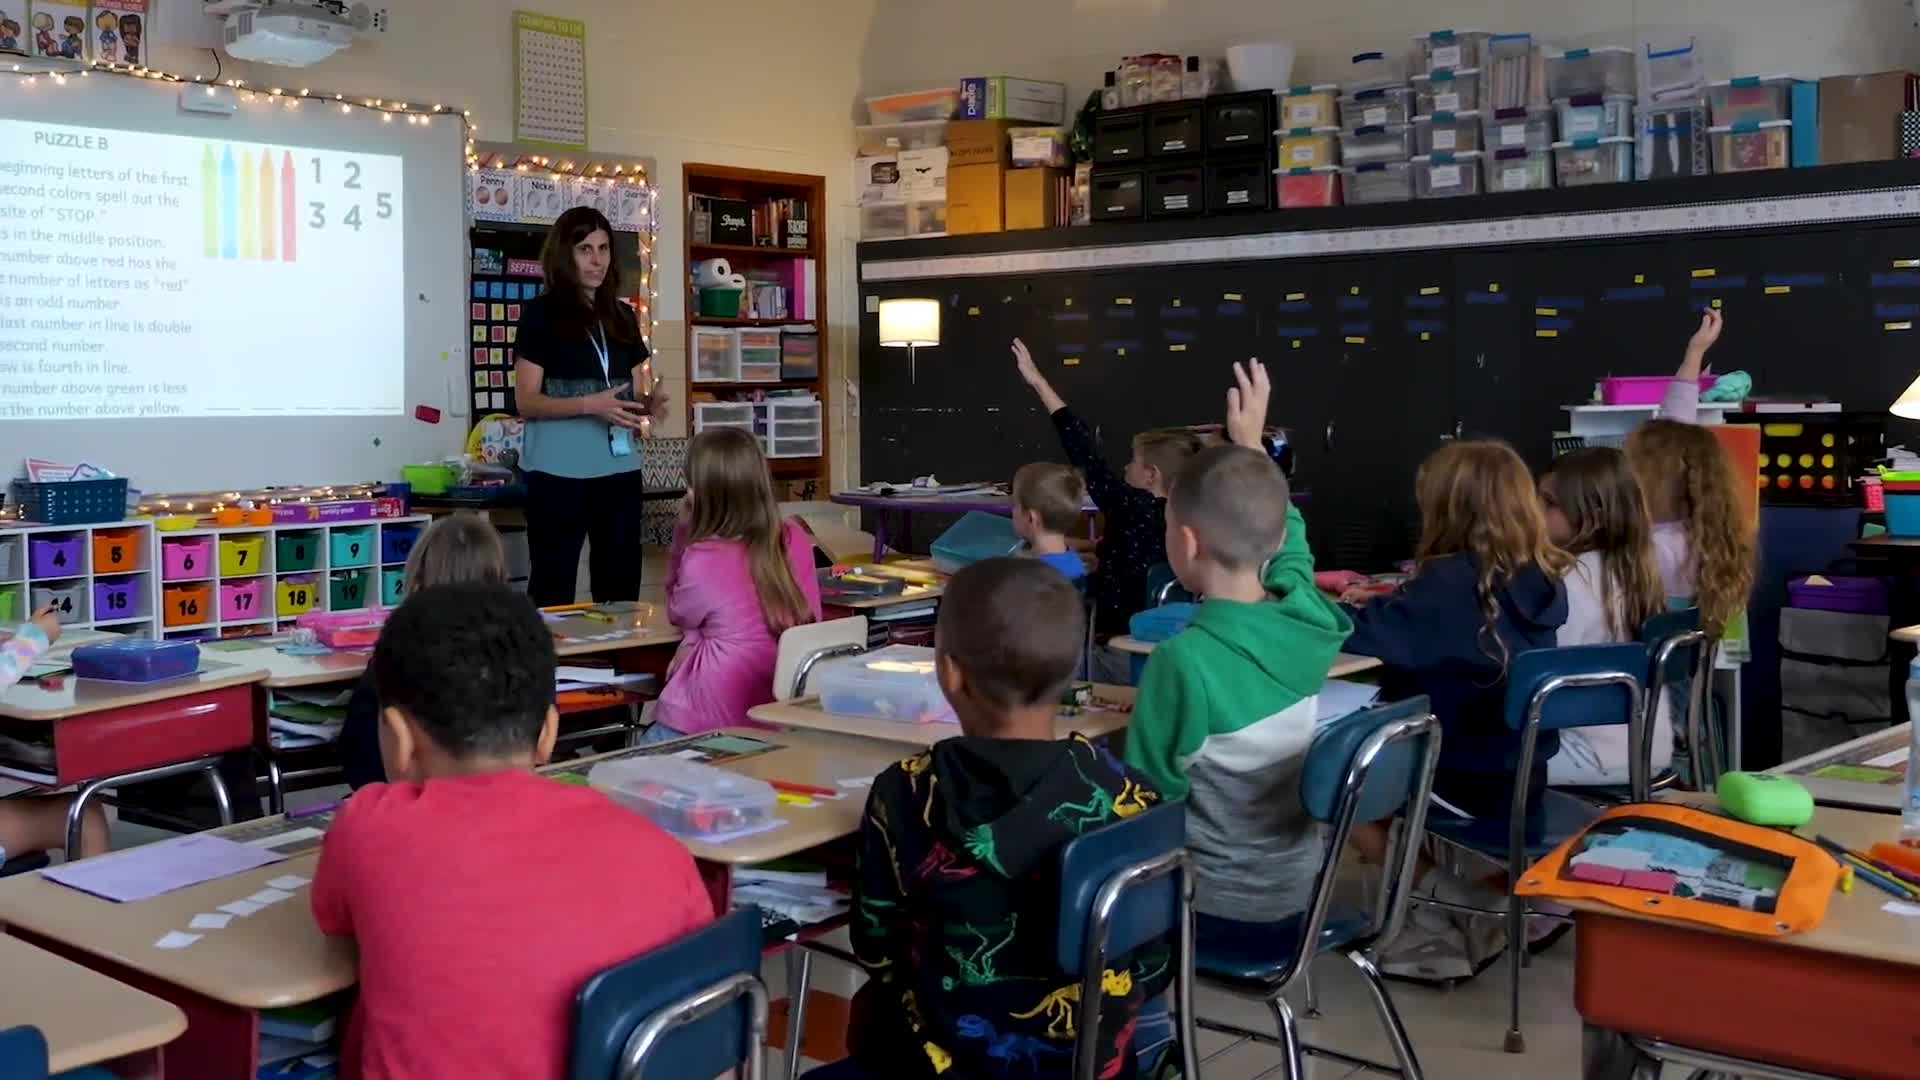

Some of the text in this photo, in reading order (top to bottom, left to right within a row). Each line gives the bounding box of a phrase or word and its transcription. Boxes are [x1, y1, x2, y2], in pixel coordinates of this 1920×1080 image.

[34, 131, 109, 151] PUZZLE B
[68, 162, 114, 181] letters
[118, 167, 133, 182] of
[135, 168, 159, 185] the
[161, 170, 190, 187] first
[311, 157, 362, 189] 1 2
[480, 175, 505, 188] Penny
[532, 181, 555, 192] Nickel
[582, 186, 600, 196] Dime
[49, 184, 91, 201] colors
[96, 189, 127, 204] spell
[132, 193, 153, 206] out
[157, 192, 180, 208] the
[31, 205, 45, 220] of
[376, 191, 392, 219] 5
[308, 201, 362, 232] 3 4
[14, 228, 26, 241] in
[31, 228, 54, 242] the
[58, 231, 104, 246] middle
[56, 252, 98, 267] above
[101, 254, 124, 268] red
[128, 256, 151, 270] has
[155, 256, 178, 271] the
[8, 273, 64, 288] number
[67, 274, 82, 288] of
[85, 275, 130, 290] letters
[134, 278, 150, 290] as
[15, 296, 33, 308] an
[37, 295, 64, 308] odd
[31, 316, 85, 330] number
[88, 320, 101, 331] in
[105, 319, 129, 333] line
[133, 320, 145, 333] is
[148, 321, 193, 335] double
[23, 360, 35, 374] is
[38, 359, 82, 374] fourth
[87, 360, 99, 374] in
[61, 382, 103, 395] above
[106, 384, 145, 397] green
[148, 382, 159, 395] is
[162, 381, 188, 395] less
[10, 402, 34, 417] the
[38, 402, 90, 417] number
[95, 402, 136, 416] above
[53, 549, 67, 567] 4
[111, 546, 122, 563] 5
[237, 550, 249, 566] 7
[296, 545, 305, 561] 8
[350, 543, 360, 558] 9
[183, 553, 194, 571] 6
[342, 585, 358, 601] 19
[394, 579, 404, 595] 2
[107, 592, 127, 610] 15
[234, 593, 253, 611] 17
[288, 590, 306, 606] 18
[178, 599, 198, 616] 16
